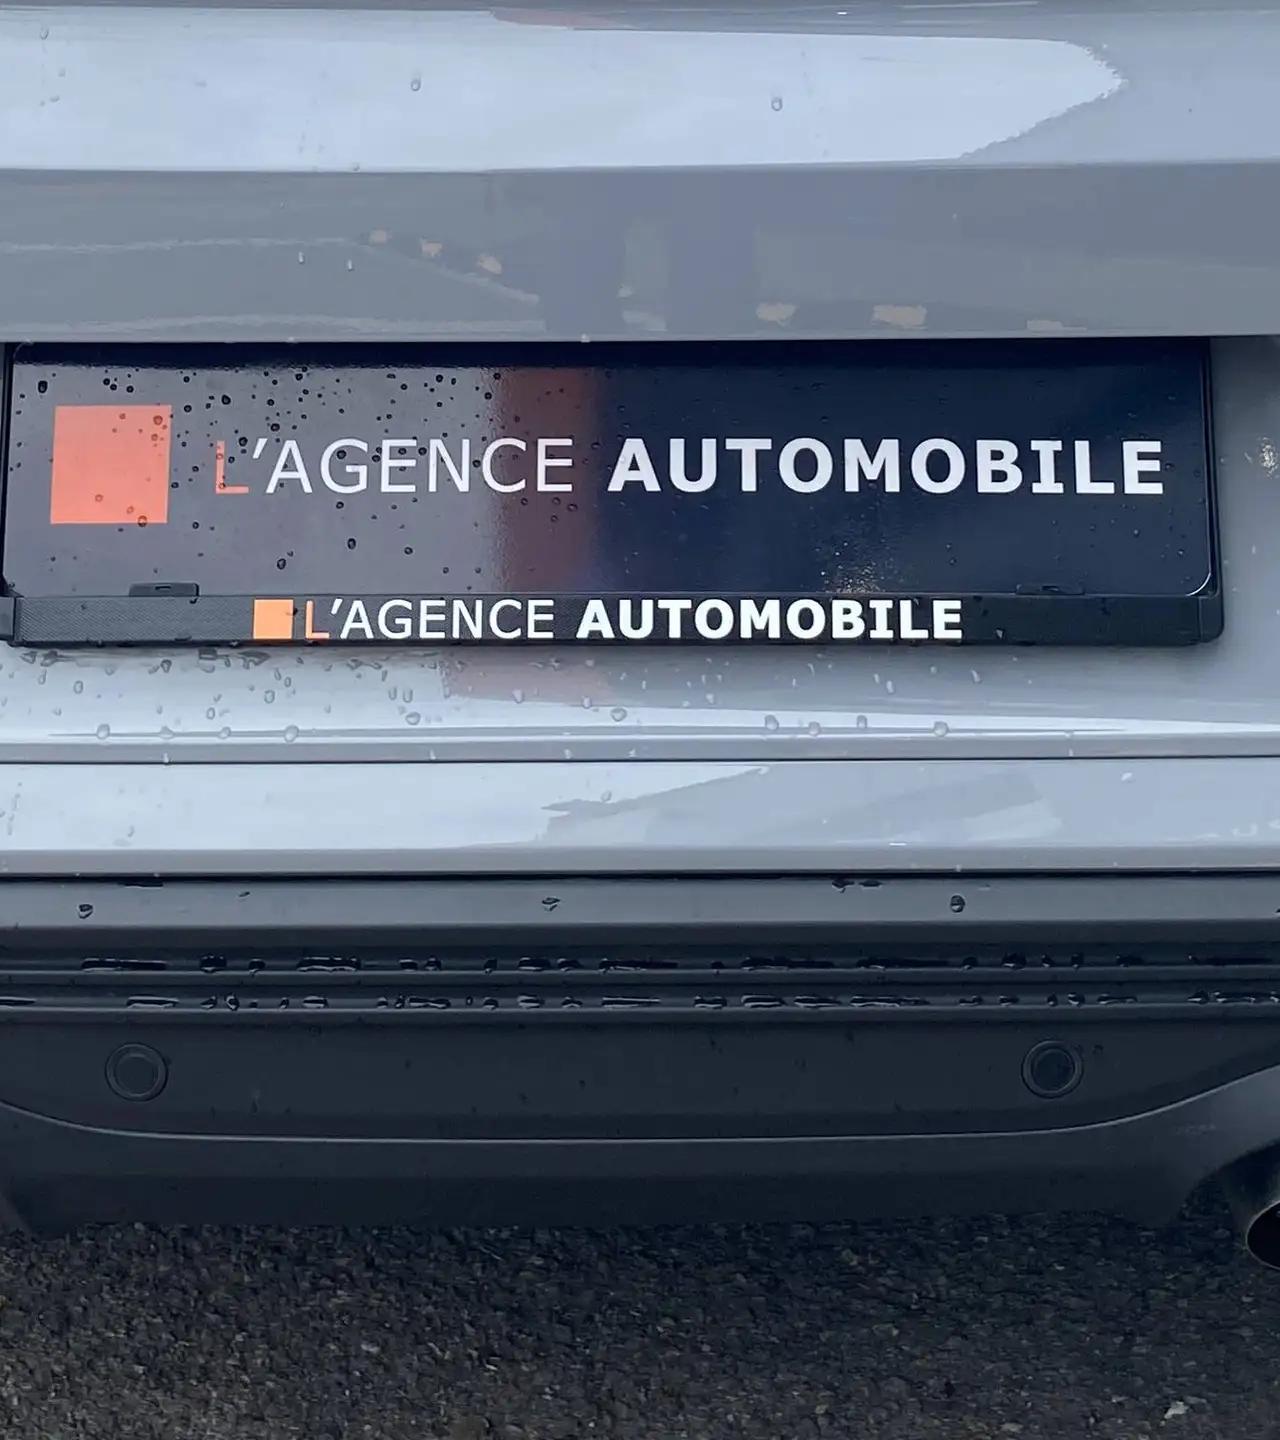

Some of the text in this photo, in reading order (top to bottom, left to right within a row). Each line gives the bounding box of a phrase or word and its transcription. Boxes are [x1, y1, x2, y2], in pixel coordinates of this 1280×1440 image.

[215, 437, 1164, 495] L'AGENCE AUTOMOBILE
[304, 598, 963, 640] L'AGENCE AUTOMOBILE
